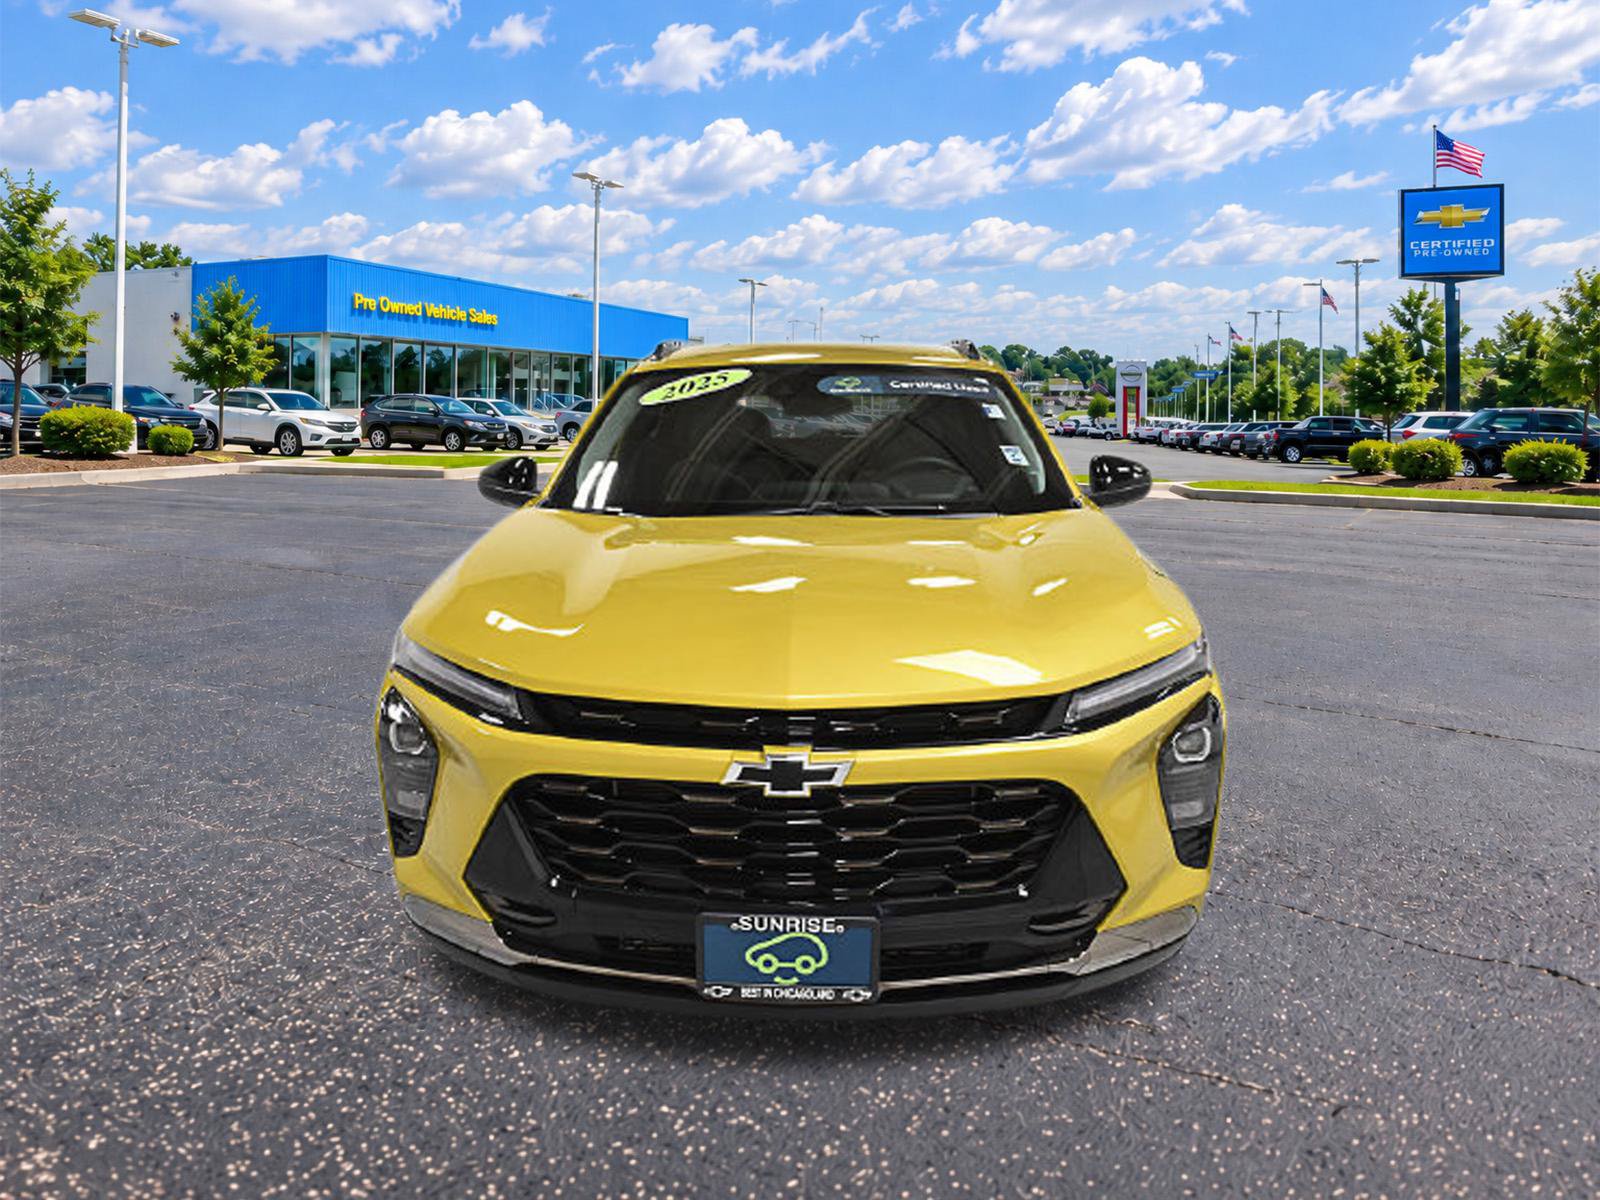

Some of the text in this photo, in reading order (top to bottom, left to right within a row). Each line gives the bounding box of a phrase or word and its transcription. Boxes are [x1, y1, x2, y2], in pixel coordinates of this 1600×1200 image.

[1410, 239, 1495, 249] CERTIFIED
[1414, 248, 1490, 257] PRE-OWNED
[354, 293, 498, 325] Pre Owned Vehicle Sales
[661, 372, 729, 400] 2025
[738, 916, 836, 933] SUNRISE
[741, 987, 762, 999] BEST
